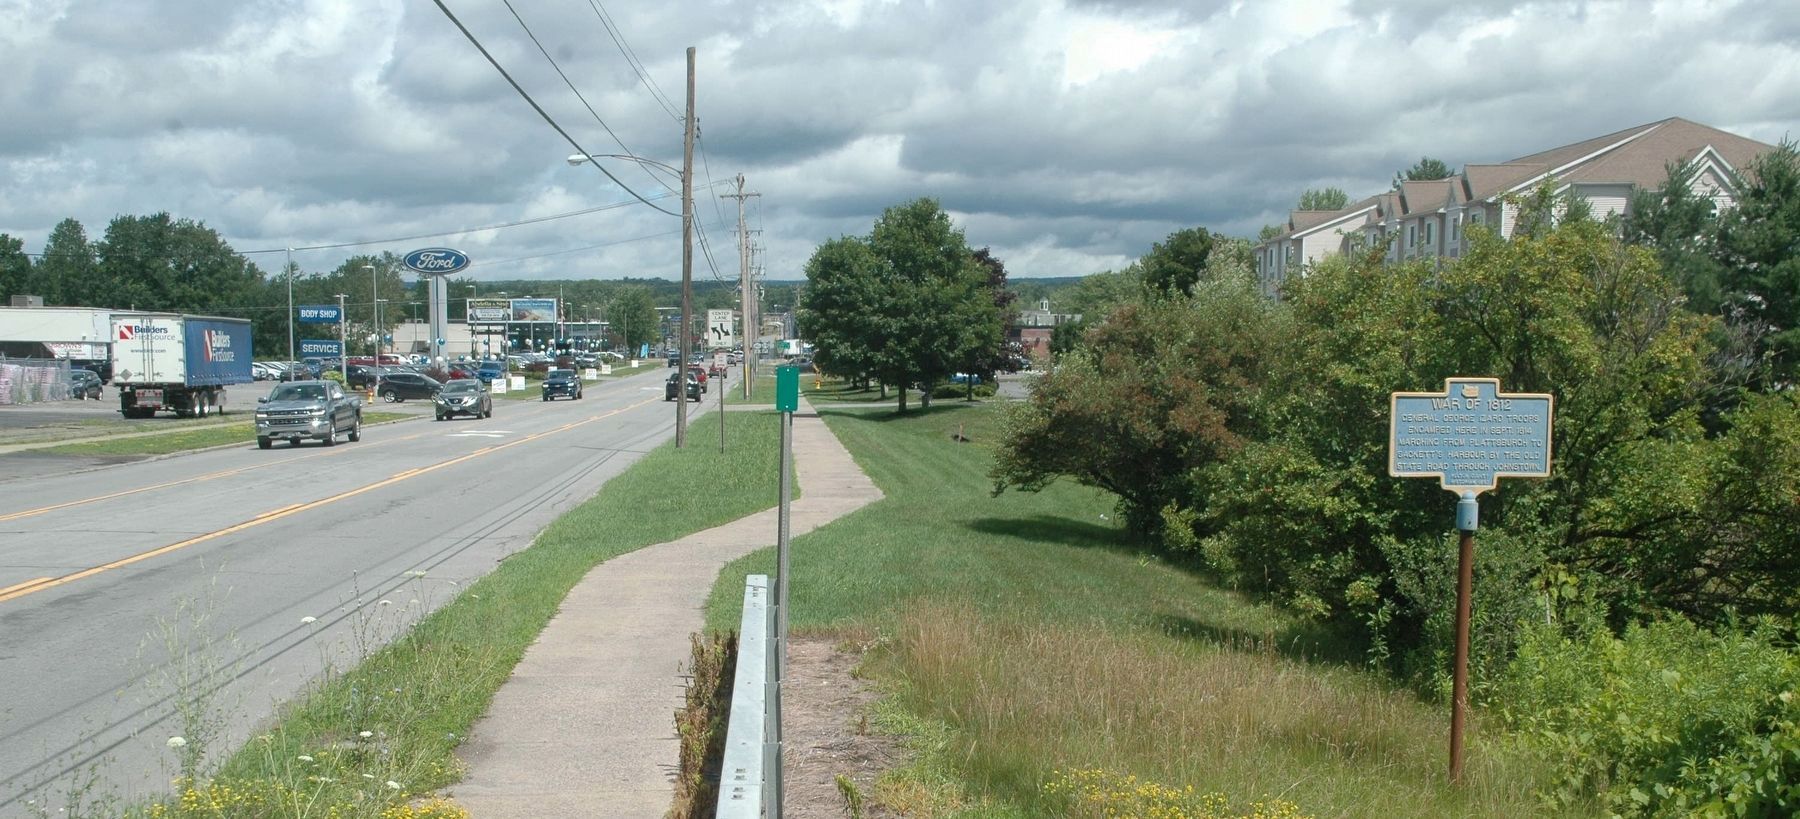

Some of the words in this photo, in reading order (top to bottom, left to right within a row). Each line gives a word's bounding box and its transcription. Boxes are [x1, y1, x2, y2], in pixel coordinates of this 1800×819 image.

[417, 252, 456, 268] Ford
[301, 309, 318, 318] BODY
[319, 310, 337, 319] SHOP
[134, 325, 168, 334] Builders
[211, 330, 231, 348] Builders
[302, 344, 339, 353] SERVICE
[1431, 398, 1460, 411] WAR
[1466, 398, 1481, 411] OF
[1487, 399, 1512, 411] 1812
[1402, 413, 1439, 423] GENERAL
[1443, 414, 1475, 423] GEORGE
[1506, 414, 1539, 423] TROOPS
[1408, 425, 1451, 434] ENCAMPED
[1455, 426, 1477, 435] HERE
[1480, 426, 1487, 435] IN
[1399, 437, 1439, 447] MARCHING
[1443, 438, 1465, 447] FROM
[1469, 438, 1527, 448] PLATTSBURGH
[1531, 438, 1542, 448] TO
[1448, 451, 1485, 460] HARBOUR
[1489, 451, 1499, 460] BY
[1503, 451, 1521, 460] THE
[1523, 451, 1540, 460] OLD
[1396, 462, 1422, 471] STATE
[1426, 462, 1449, 472] ROAD
[1453, 462, 1489, 472] THROUGH
